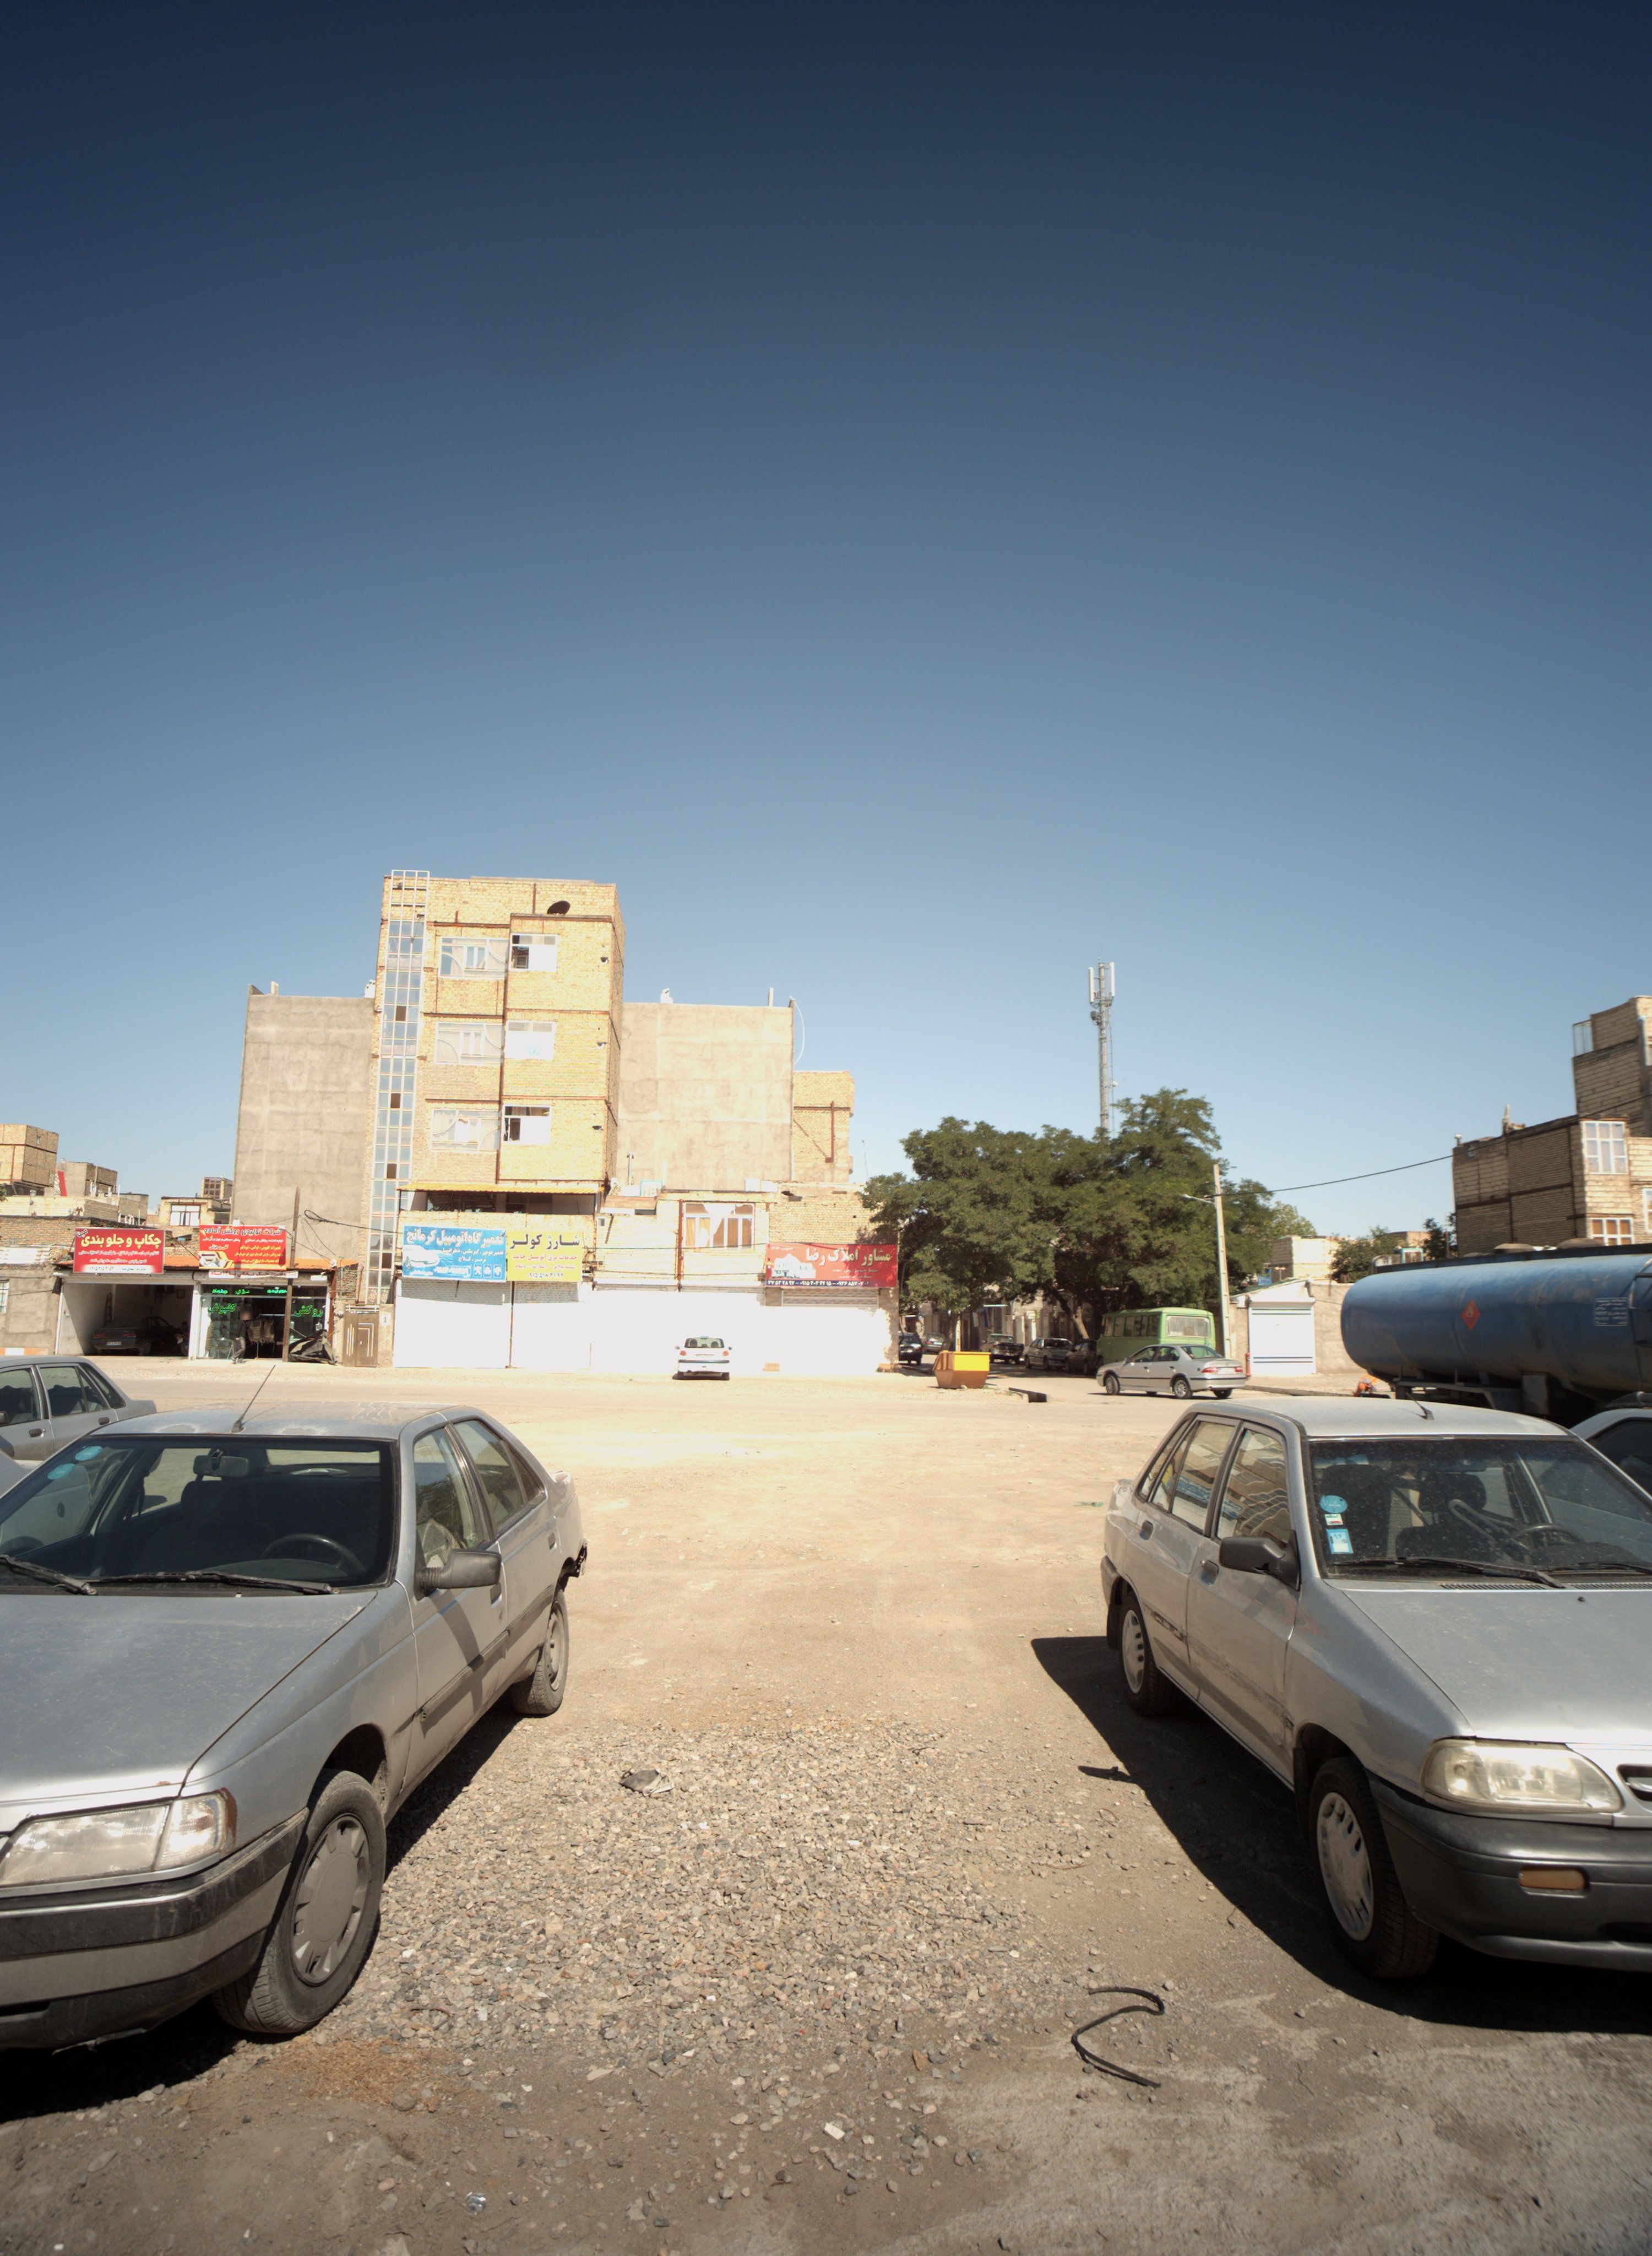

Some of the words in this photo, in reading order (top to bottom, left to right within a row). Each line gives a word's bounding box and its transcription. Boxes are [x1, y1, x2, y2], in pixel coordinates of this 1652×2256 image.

[126, 1237, 132, 1248] و
[134, 1233, 161, 1249] چکاپ
[509, 1233, 542, 1249] کولر
[546, 1234, 580, 1249] شارژ
[806, 1247, 825, 1266] رضا
[827, 1246, 858, 1262] املاک
[861, 1248, 891, 1266] مشاور
